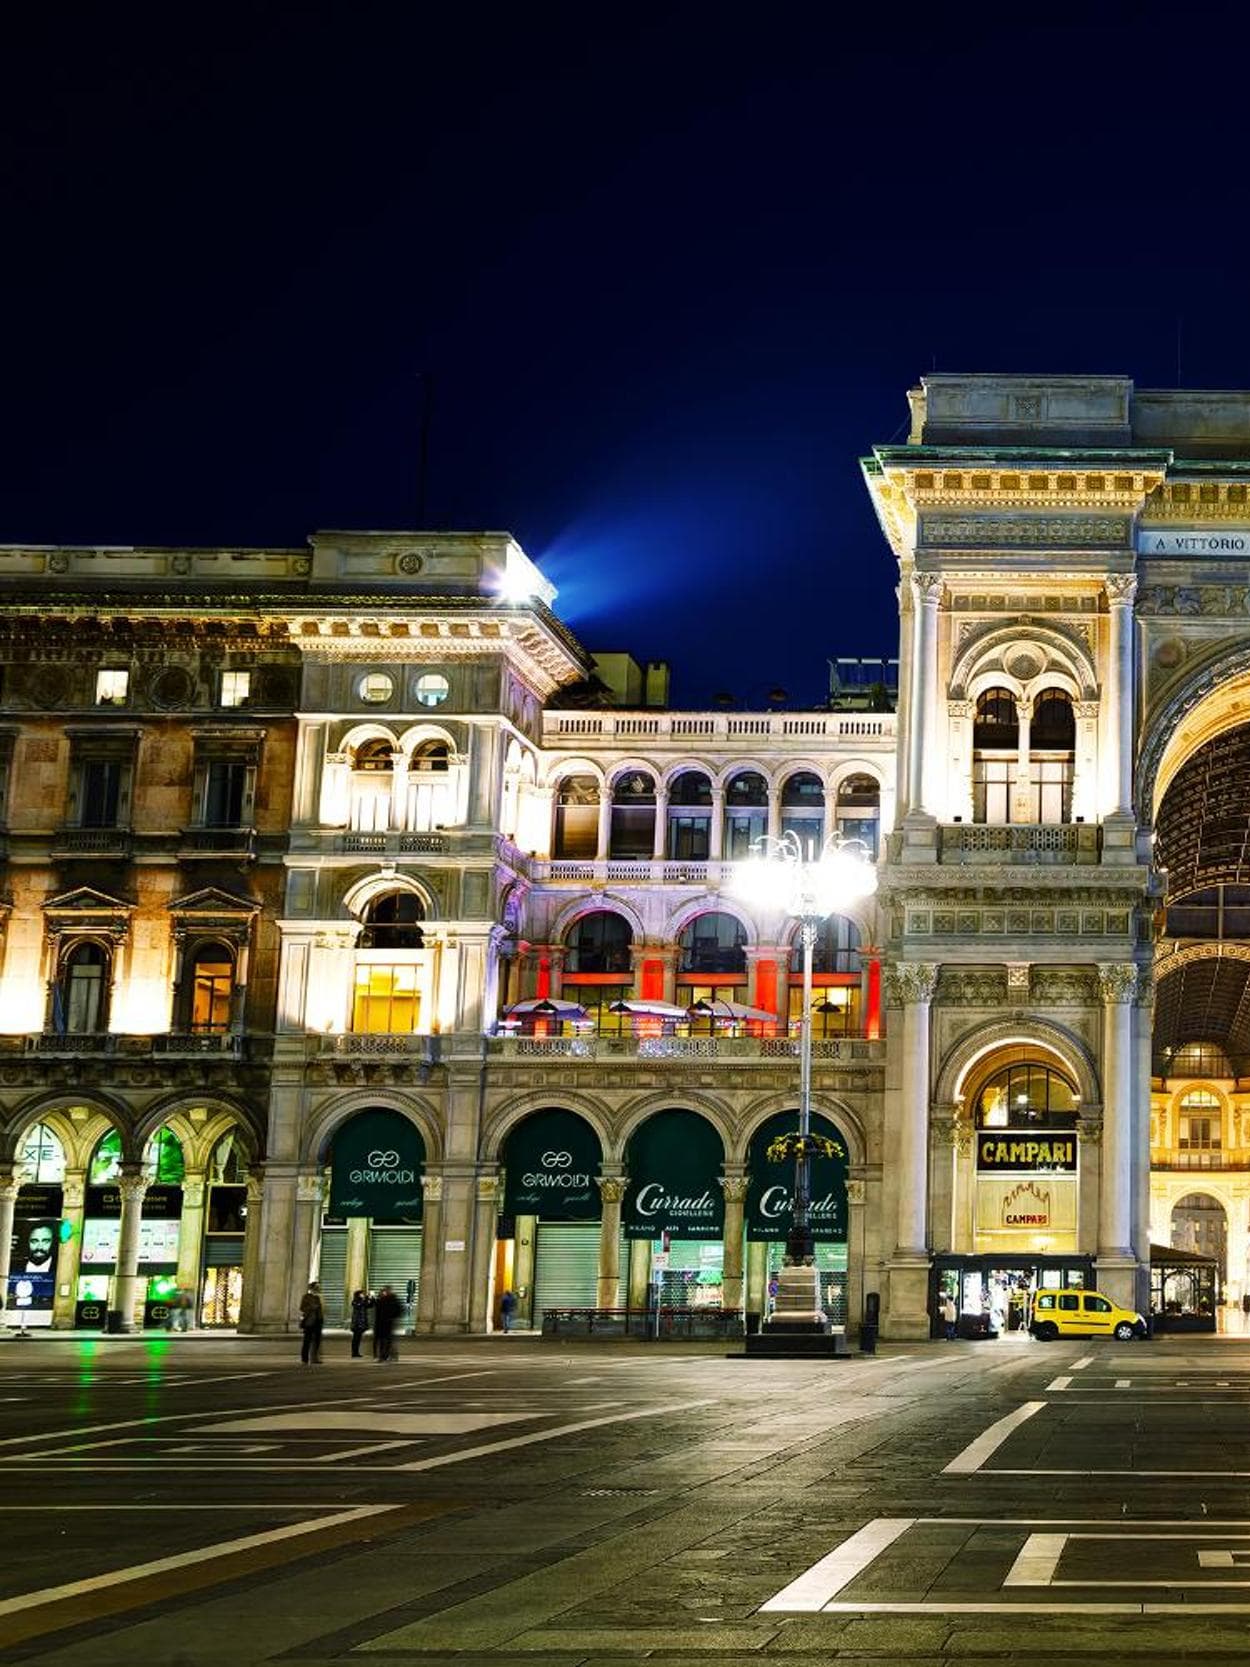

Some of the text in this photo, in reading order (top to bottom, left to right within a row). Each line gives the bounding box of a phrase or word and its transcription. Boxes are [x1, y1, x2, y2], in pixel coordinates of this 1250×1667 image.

[1156, 539, 1166, 550] A
[1176, 538, 1245, 550] VITTORIO
[982, 1141, 1073, 1163] CAMPARI
[349, 1170, 415, 1184] GRIMOLDI
[521, 1173, 590, 1187] GRIMOLDI
[636, 1183, 715, 1216] Currado
[1006, 1215, 1047, 1224] CAMPARI
